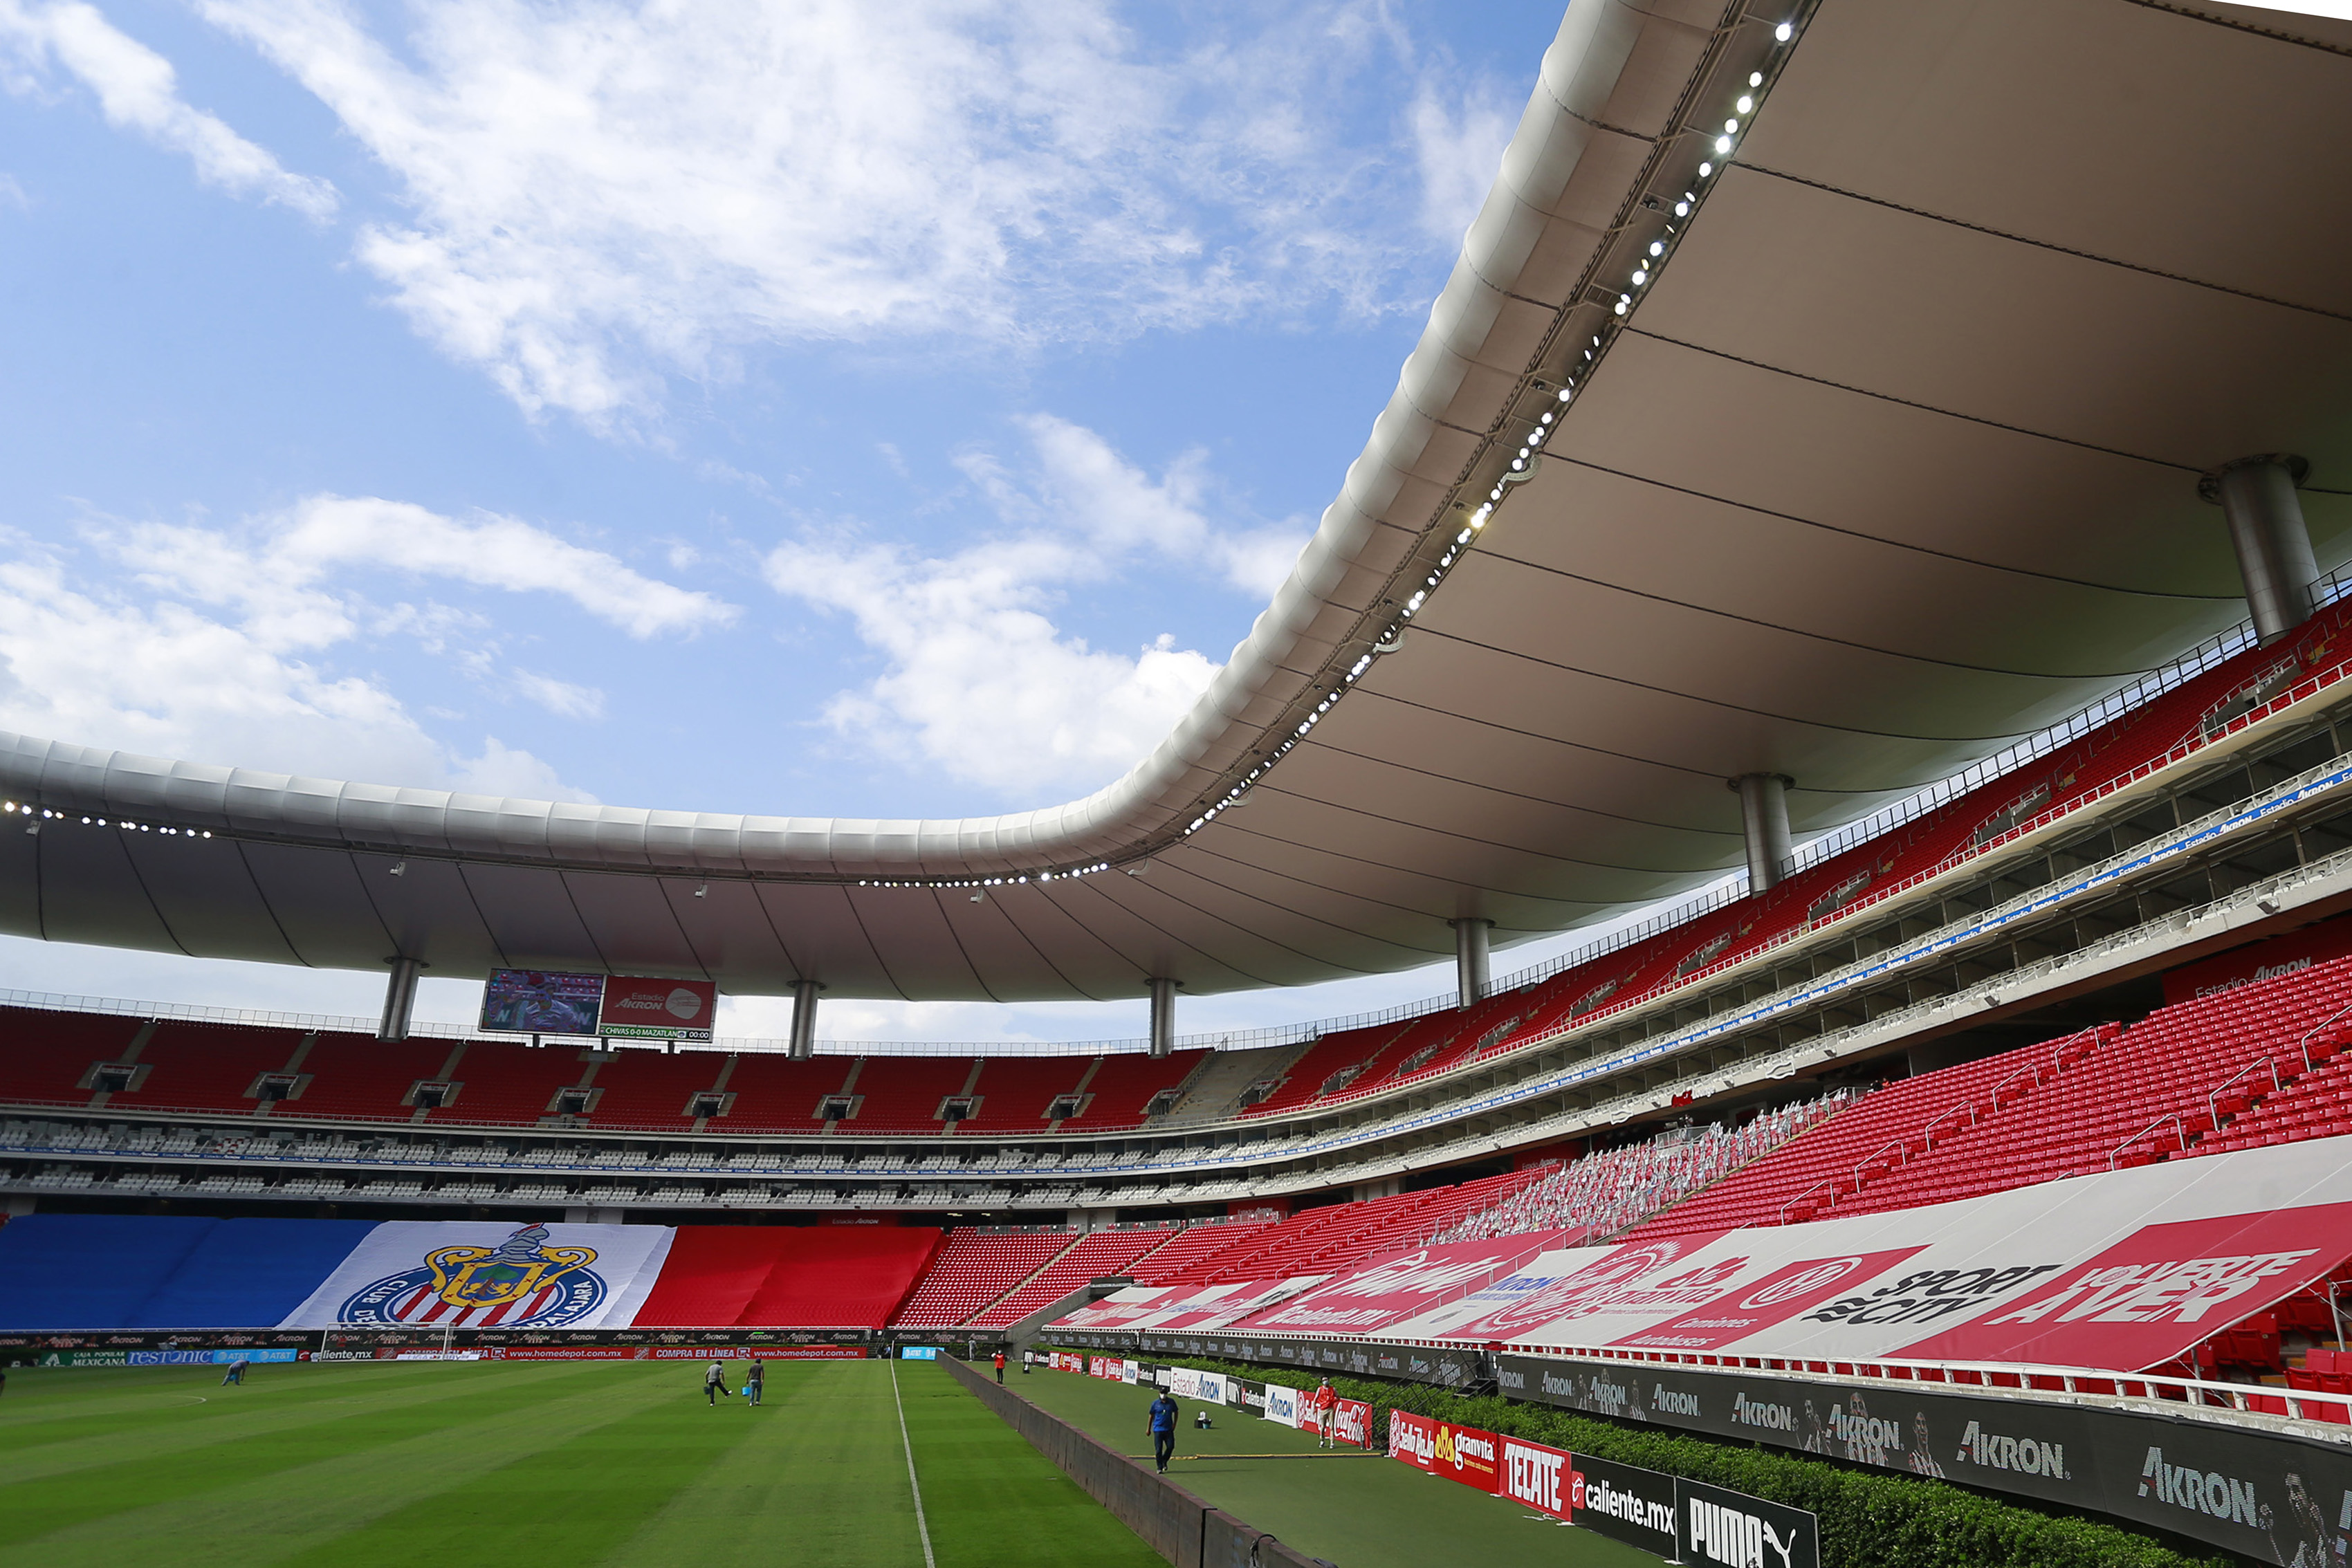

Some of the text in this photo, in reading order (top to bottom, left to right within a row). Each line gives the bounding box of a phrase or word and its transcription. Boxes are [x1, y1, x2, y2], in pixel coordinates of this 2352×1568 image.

[2260, 780, 2333, 816] Estadio AKRON
[2185, 814, 2252, 849] Estadio AKRON
[2118, 846, 2178, 876] Estadio AKRON
[2059, 874, 2112, 901] Estadio AKRON
[2005, 898, 2054, 923] Estadio AKRON
[1956, 920, 2001, 943] Estadio AKRON
[1931, 940, 1951, 952] AKRON
[2195, 957, 2311, 999] Estadio AKRON
[615, 998, 662, 1011] AKRON
[632, 993, 665, 1002] Estadio
[605, 1027, 630, 1036] CHIVAS
[1872, 1264, 2066, 1297] SPORT
[2066, 1248, 2321, 1290] VOLVERTE
[369, 1280, 409, 1305] CLUB
[1565, 1288, 1724, 1320] granvita
[1983, 1276, 2259, 1325] A VER
[1672, 1317, 1758, 1329] Camiones
[1847, 1297, 1996, 1325] CITY
[105, 1336, 145, 1344] AKRON
[656, 1347, 734, 1358] COMPRA EN LÍNEA
[754, 1349, 858, 1358] www.homedepot.com.mx
[1624, 1334, 1716, 1347] Autobuses
[71, 1358, 125, 1366] MEXICANA
[1173, 1373, 1195, 1395] Estadio
[1196, 1374, 1220, 1401] AKRON
[1496, 1366, 1525, 1389] AKRON
[1542, 1371, 1572, 1396] AKRON
[1589, 1376, 1626, 1405] AKRON
[1267, 1392, 1293, 1419] AKRON
[1651, 1383, 1699, 1417] AKRON
[1731, 1392, 1792, 1431] AKRON
[1399, 1421, 1416, 1453] Sello
[1826, 1404, 1899, 1450] AKRON
[1455, 1430, 1495, 1470] granvita
[1956, 1421, 2064, 1479] AKRON
[1504, 1442, 1563, 1513] TECATE
[2138, 1446, 2257, 1527] AKRON
[1585, 1479, 1675, 1535] caliente.mx
[1690, 1497, 1763, 1568] PUMA
